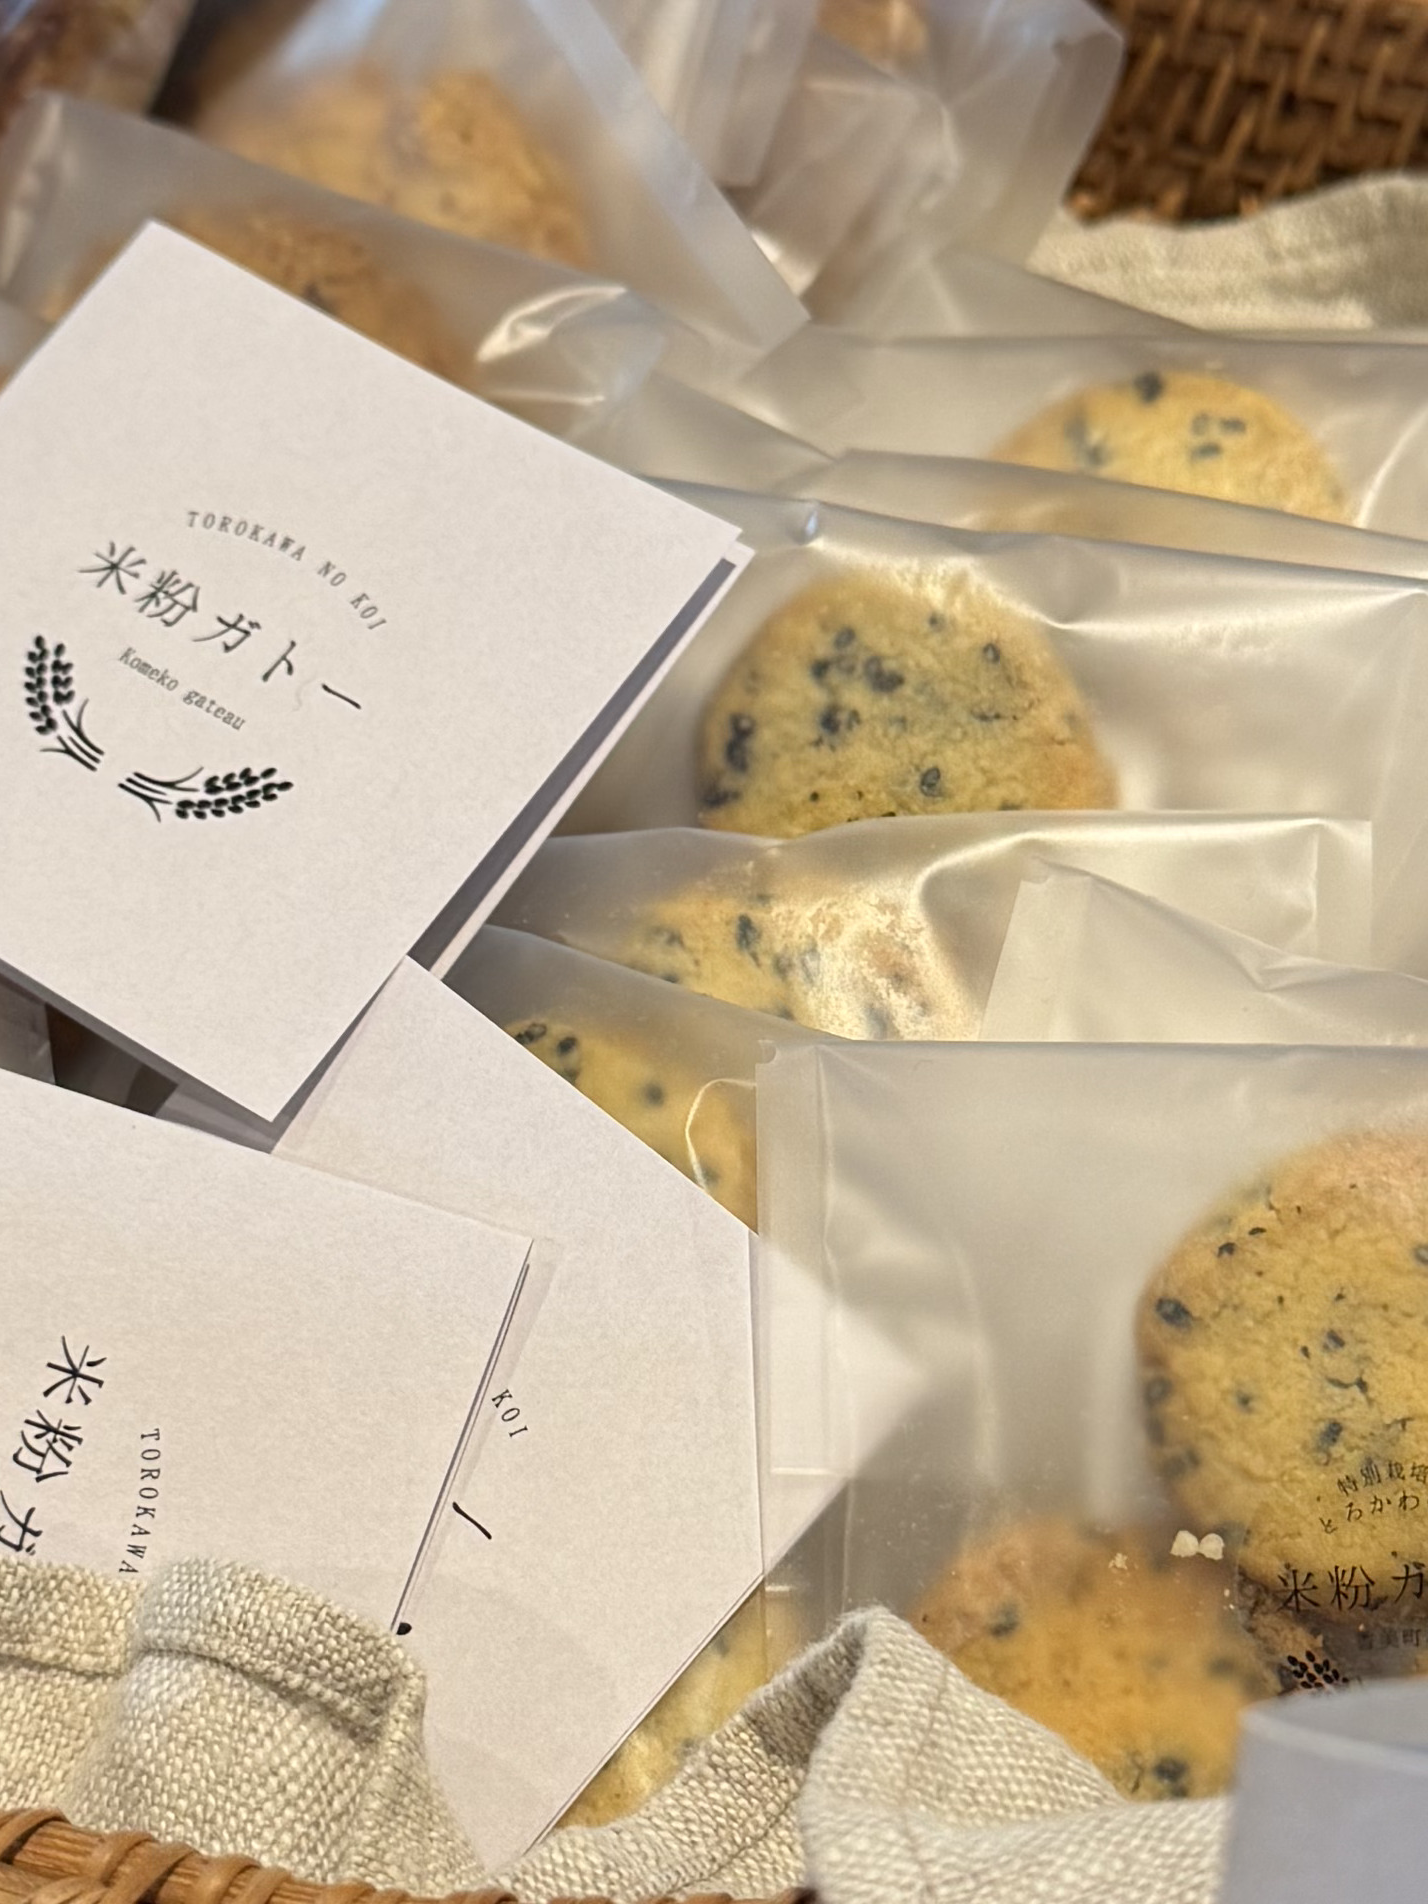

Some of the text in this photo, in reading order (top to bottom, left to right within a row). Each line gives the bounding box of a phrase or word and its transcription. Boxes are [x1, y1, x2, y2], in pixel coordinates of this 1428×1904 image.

[77, 541, 361, 709] 米粉ガトー
[187, 512, 387, 630] TOROKAWA NO KOI
[119, 647, 246, 731] Komeko gateau
[491, 1389, 528, 1437] KOI
[119, 1428, 161, 1573] TOROKAWA
